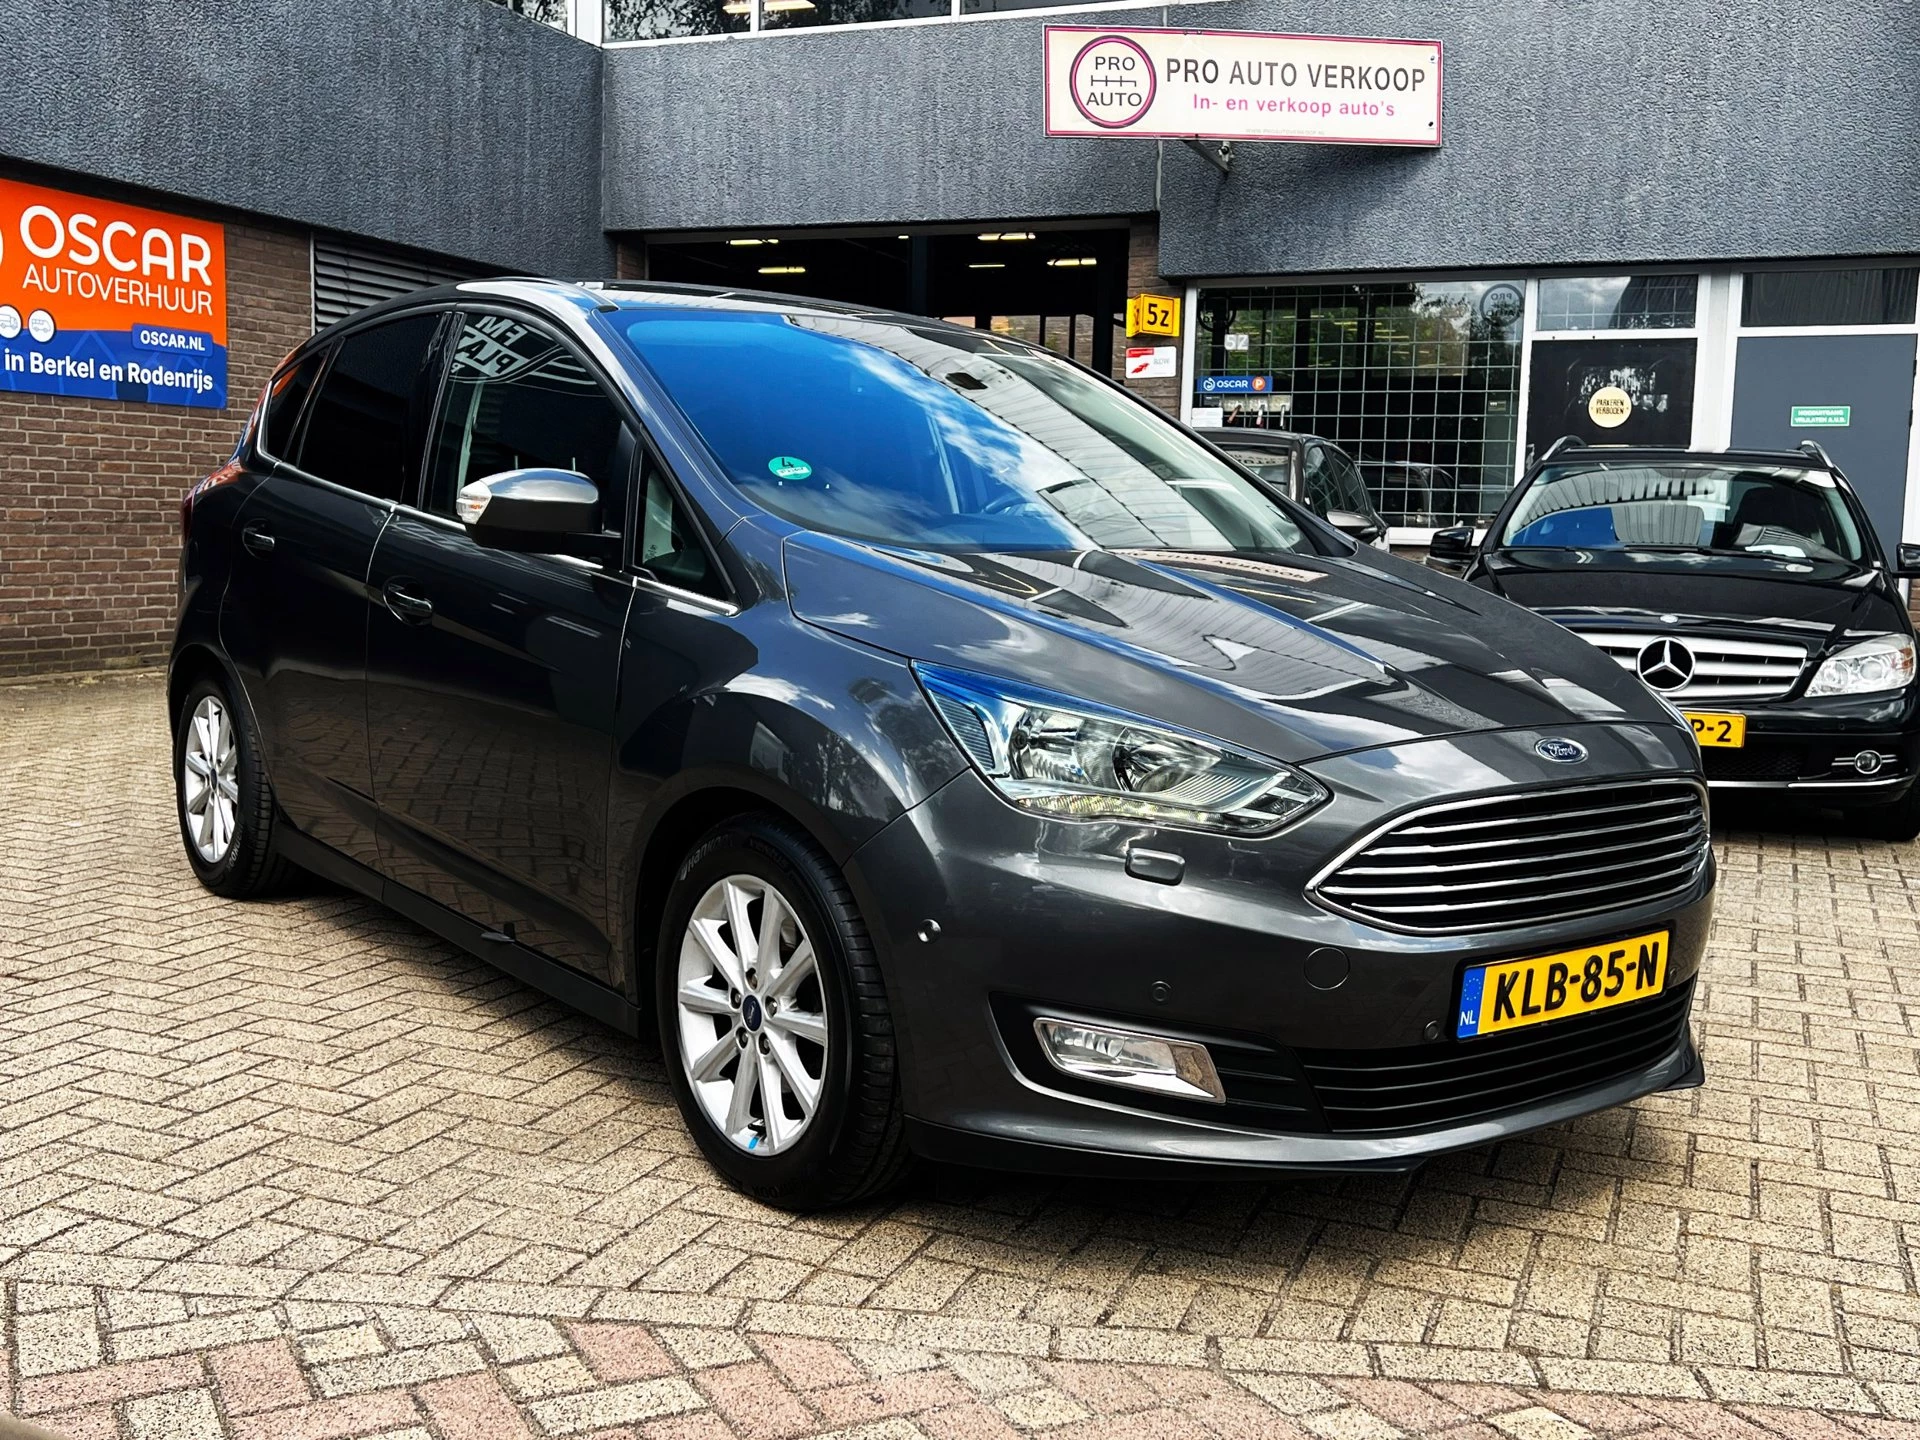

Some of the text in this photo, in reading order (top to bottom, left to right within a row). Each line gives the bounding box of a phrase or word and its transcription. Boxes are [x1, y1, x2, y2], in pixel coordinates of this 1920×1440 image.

[1095, 56, 1136, 71] PRO
[1166, 58, 1425, 92] PRO AUTO VERKOOP
[1086, 92, 1142, 107] AUTO
[1193, 93, 1395, 117] In- en verkoop auto's
[19, 205, 213, 287] OSCAR
[22, 263, 213, 317] AUTOVERHUUR
[140, 330, 206, 352] OSCAR.NL
[4, 348, 214, 394] in Berkel en Rodenrijs
[1217, 380, 1248, 389] OSCAR
[1690, 718, 1732, 743] P-2
[1547, 742, 1577, 757] Ford
[1493, 941, 1660, 1022] KLB-85-N
[1460, 1009, 1476, 1026] NL
